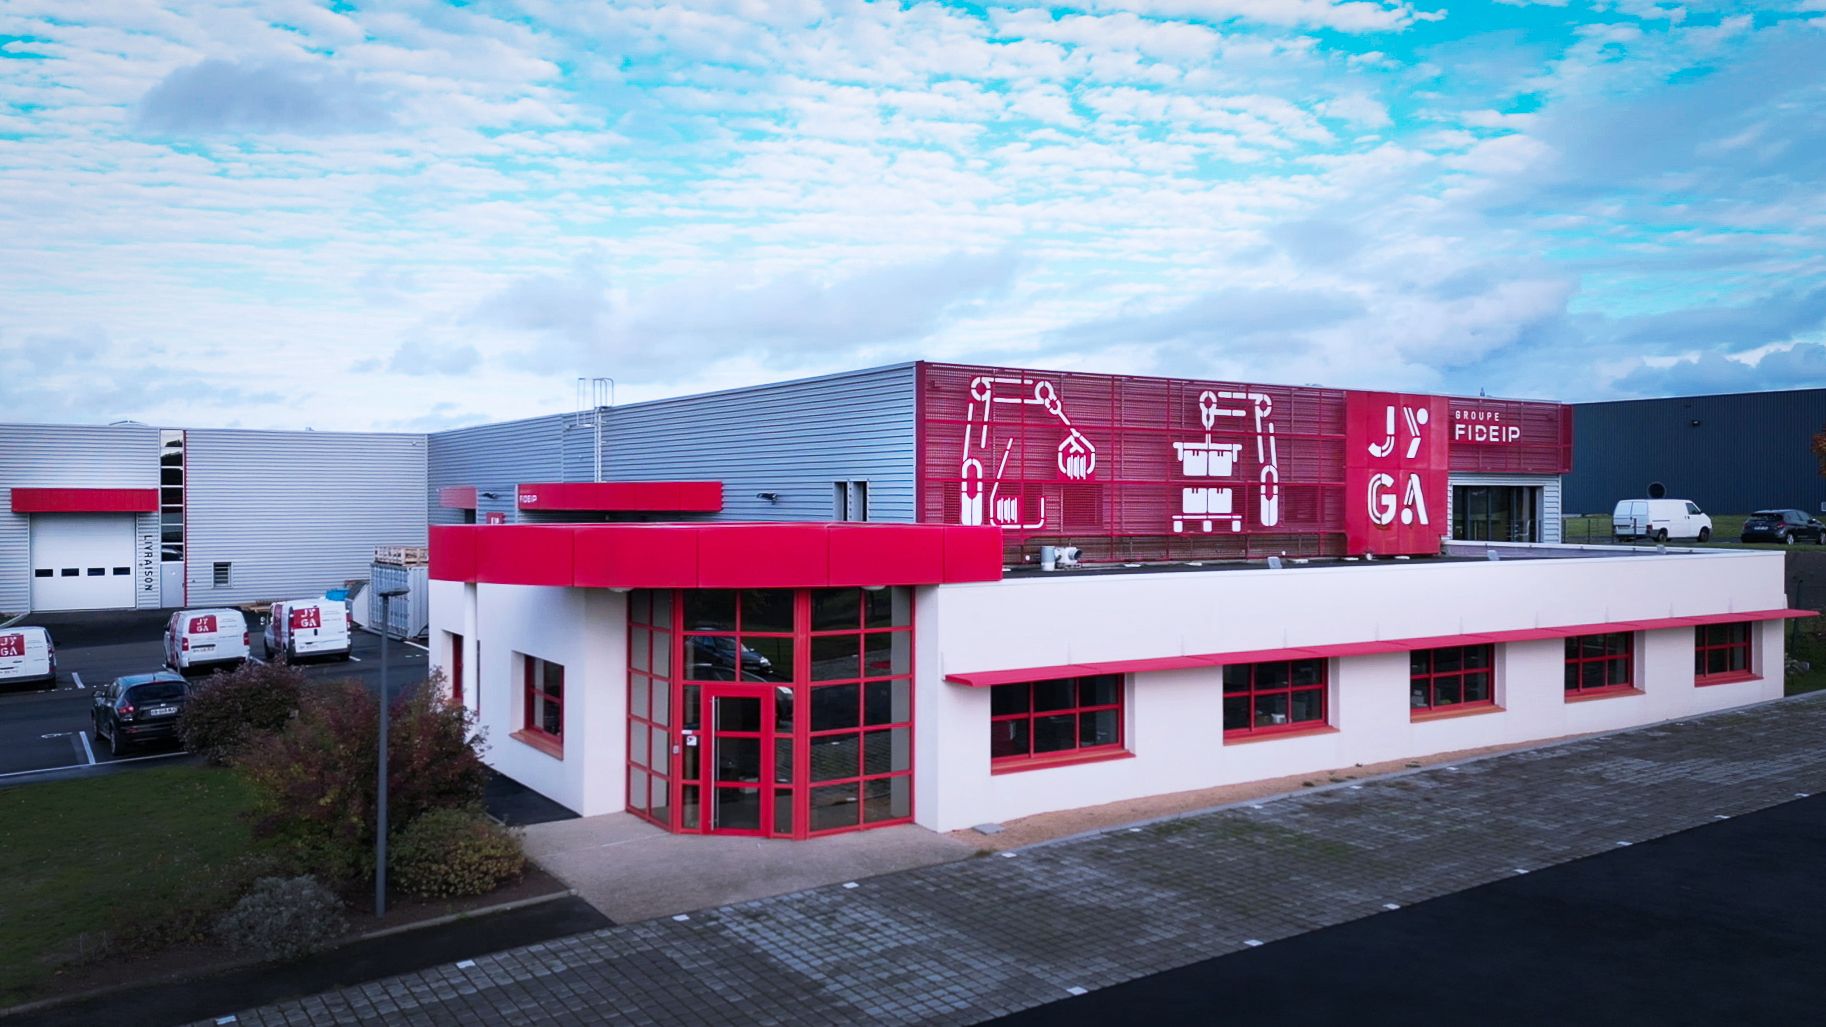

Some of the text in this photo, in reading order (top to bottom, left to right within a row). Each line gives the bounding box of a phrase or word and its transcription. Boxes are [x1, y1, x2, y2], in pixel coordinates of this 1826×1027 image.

[1368, 406, 1428, 458] JY
[1455, 410, 1500, 422] GROUPE
[1455, 424, 1520, 442] FIDEIP
[1368, 473, 1428, 525] GA
[144, 535, 153, 591] LIVRAISON
[301, 618, 317, 627] GA
